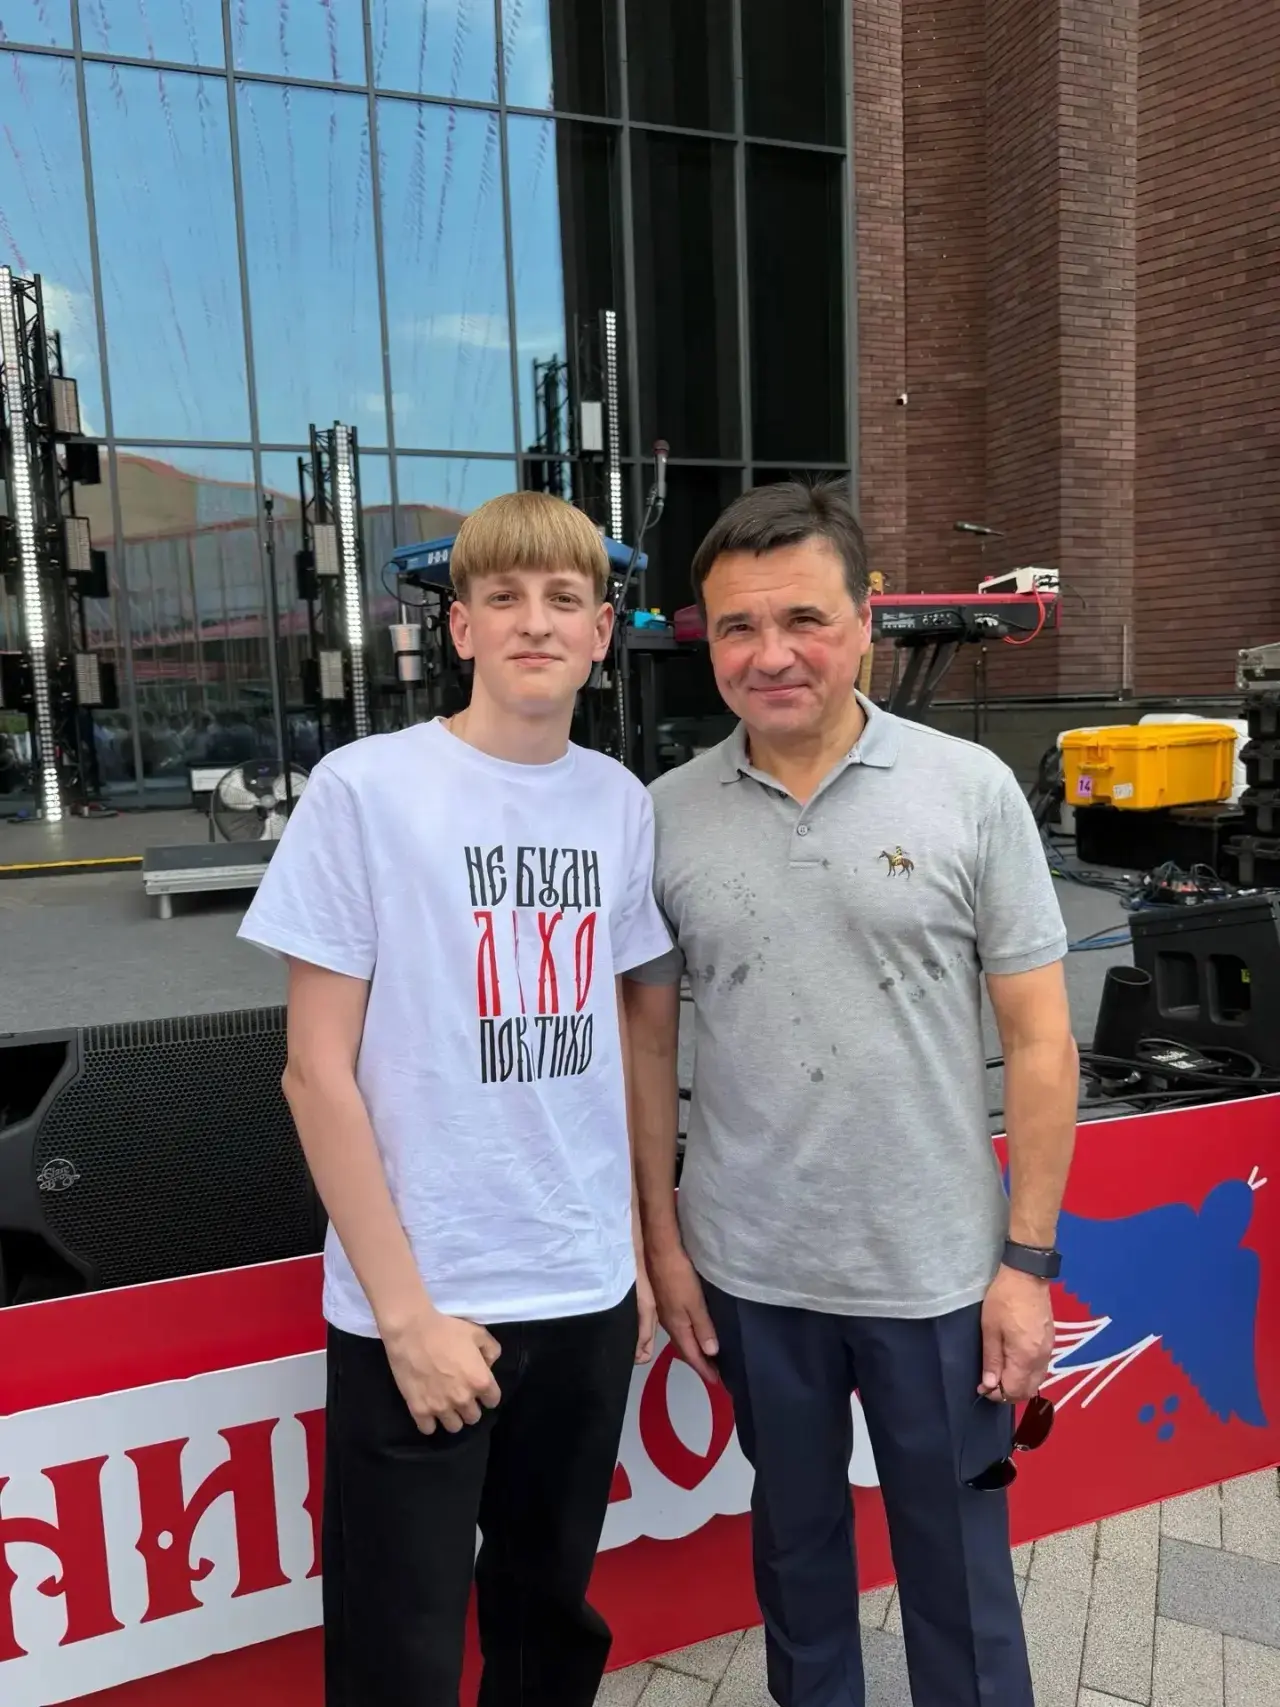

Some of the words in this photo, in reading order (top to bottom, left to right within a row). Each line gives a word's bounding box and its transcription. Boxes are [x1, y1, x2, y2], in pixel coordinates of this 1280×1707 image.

[1079, 780, 1091, 792] 14
[463, 845, 508, 907] НЕ
[515, 846, 602, 913] БУДИ
[473, 910, 597, 1018] ЛХО
[479, 1016, 537, 1084] ПОК
[534, 1013, 594, 1080] ТИХО
